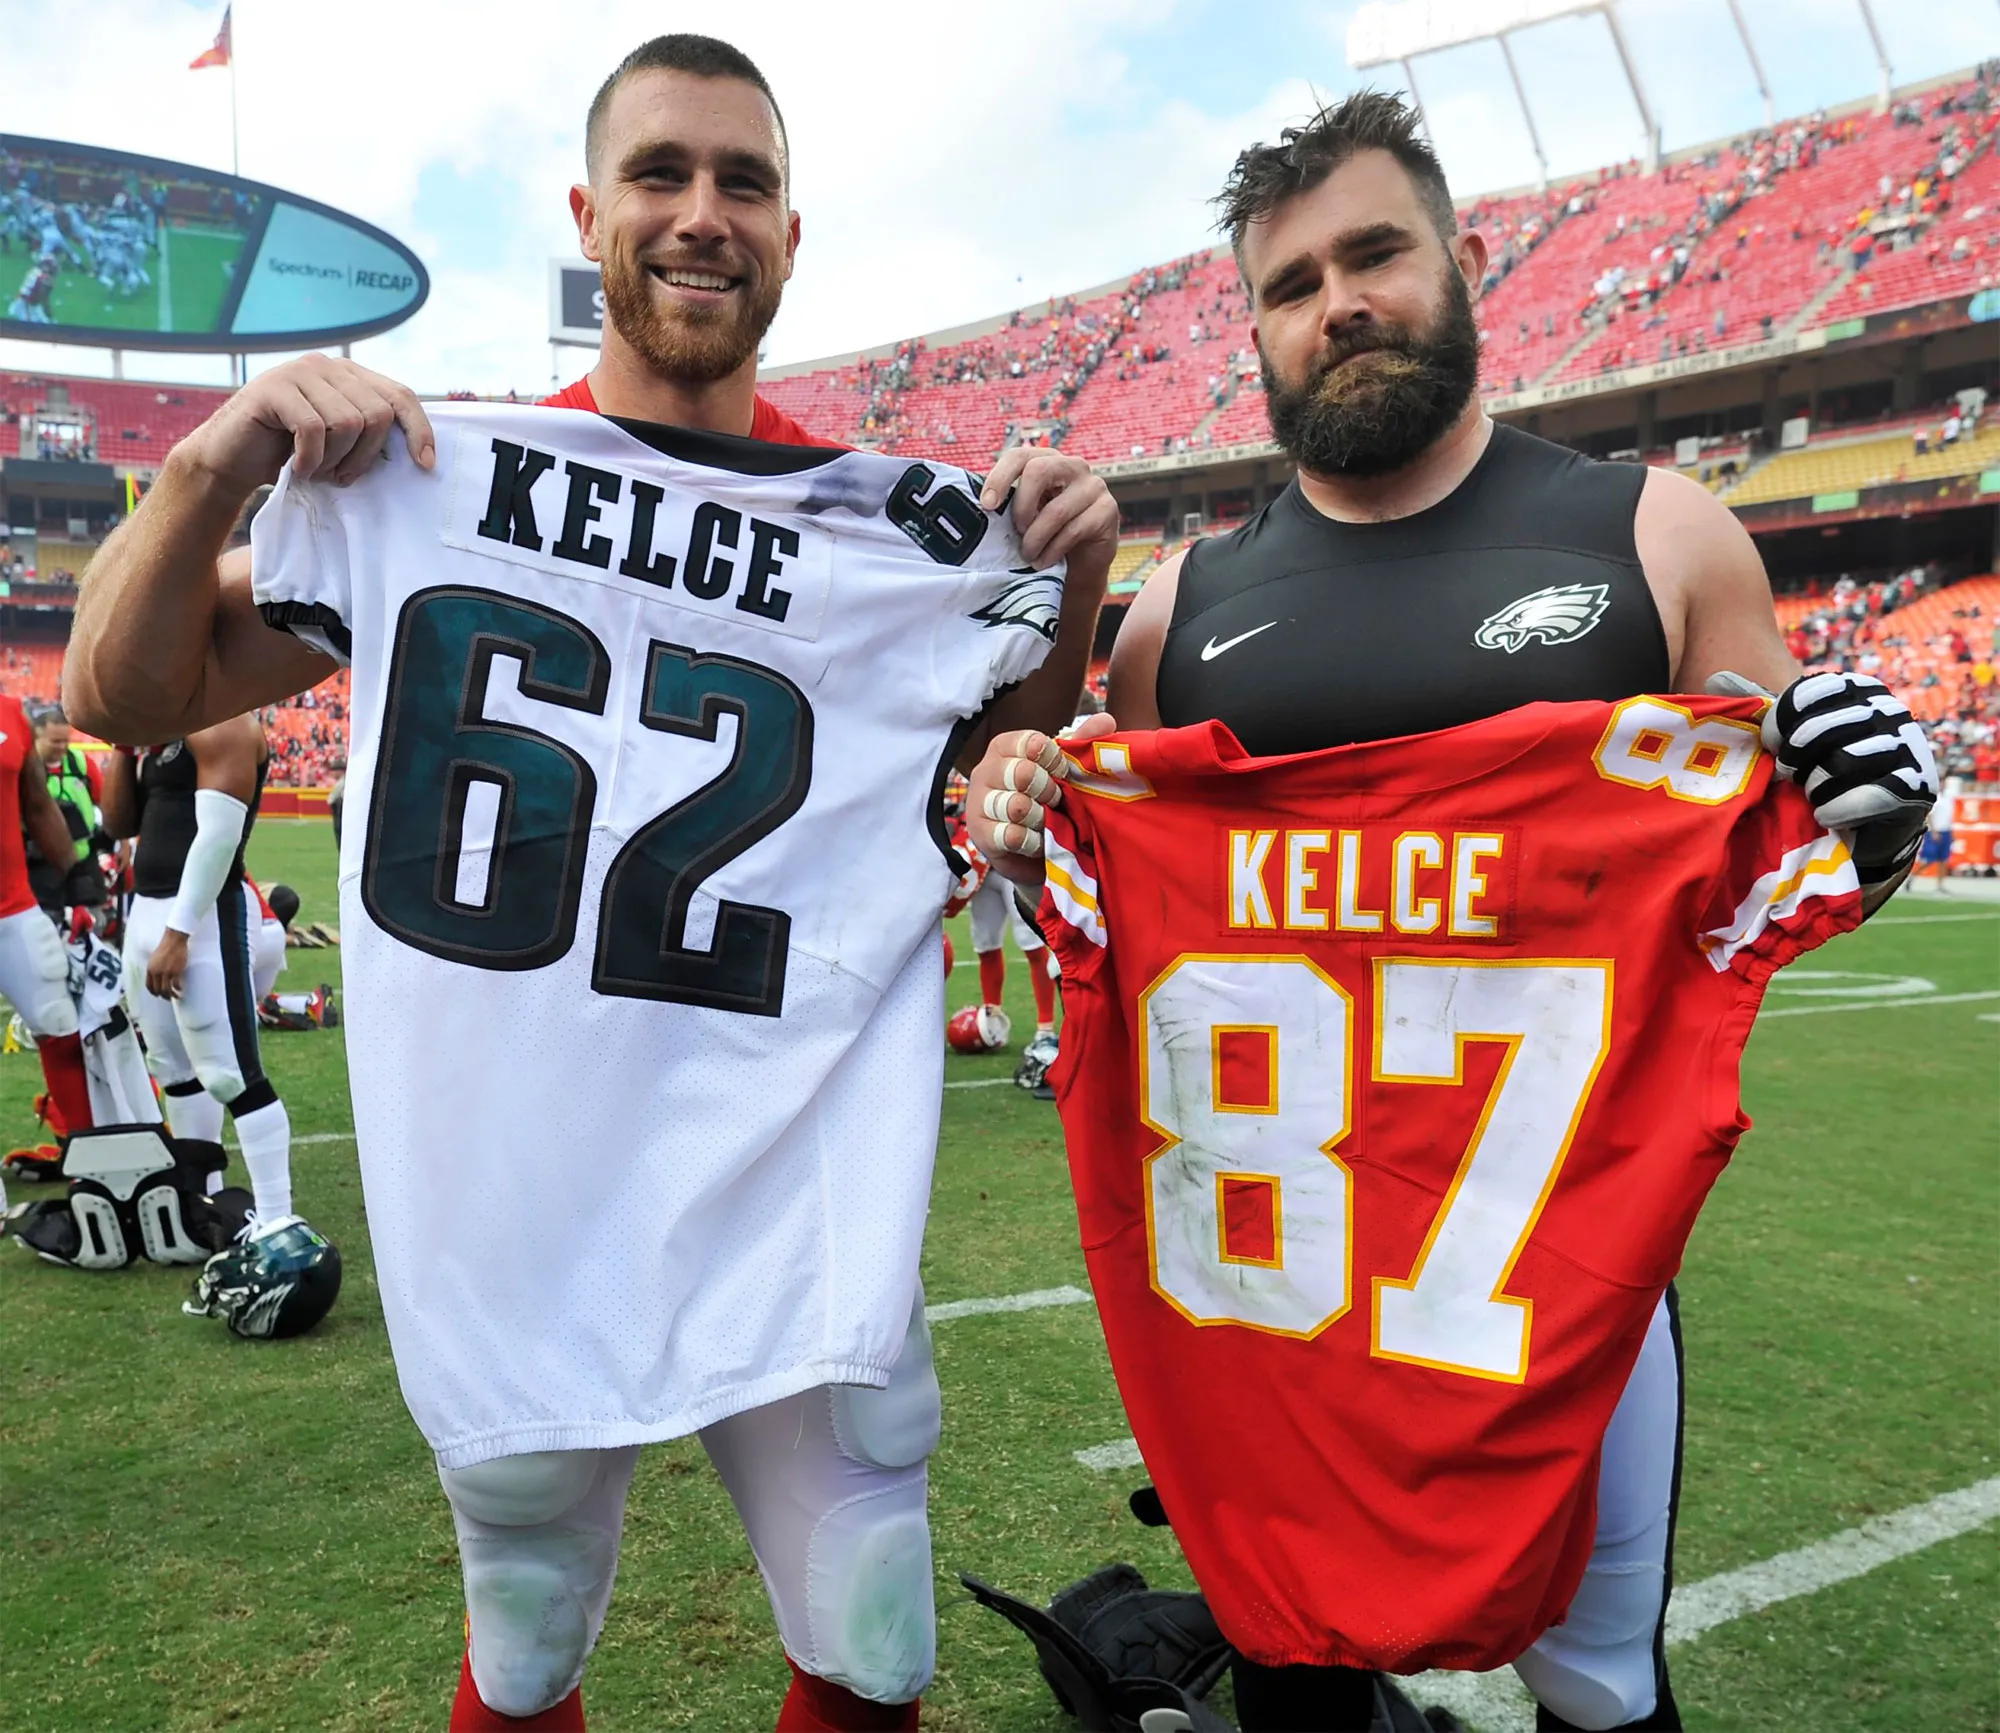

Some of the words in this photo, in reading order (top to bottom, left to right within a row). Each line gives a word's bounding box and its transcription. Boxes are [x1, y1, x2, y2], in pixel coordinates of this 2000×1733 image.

[355, 269, 414, 292] RECAP
[477, 438, 800, 623] KELCE
[361, 584, 814, 1018] 62
[1591, 694, 1774, 806] 8
[1229, 829, 1504, 937] KELCE
[1139, 953, 1615, 1384] 87
